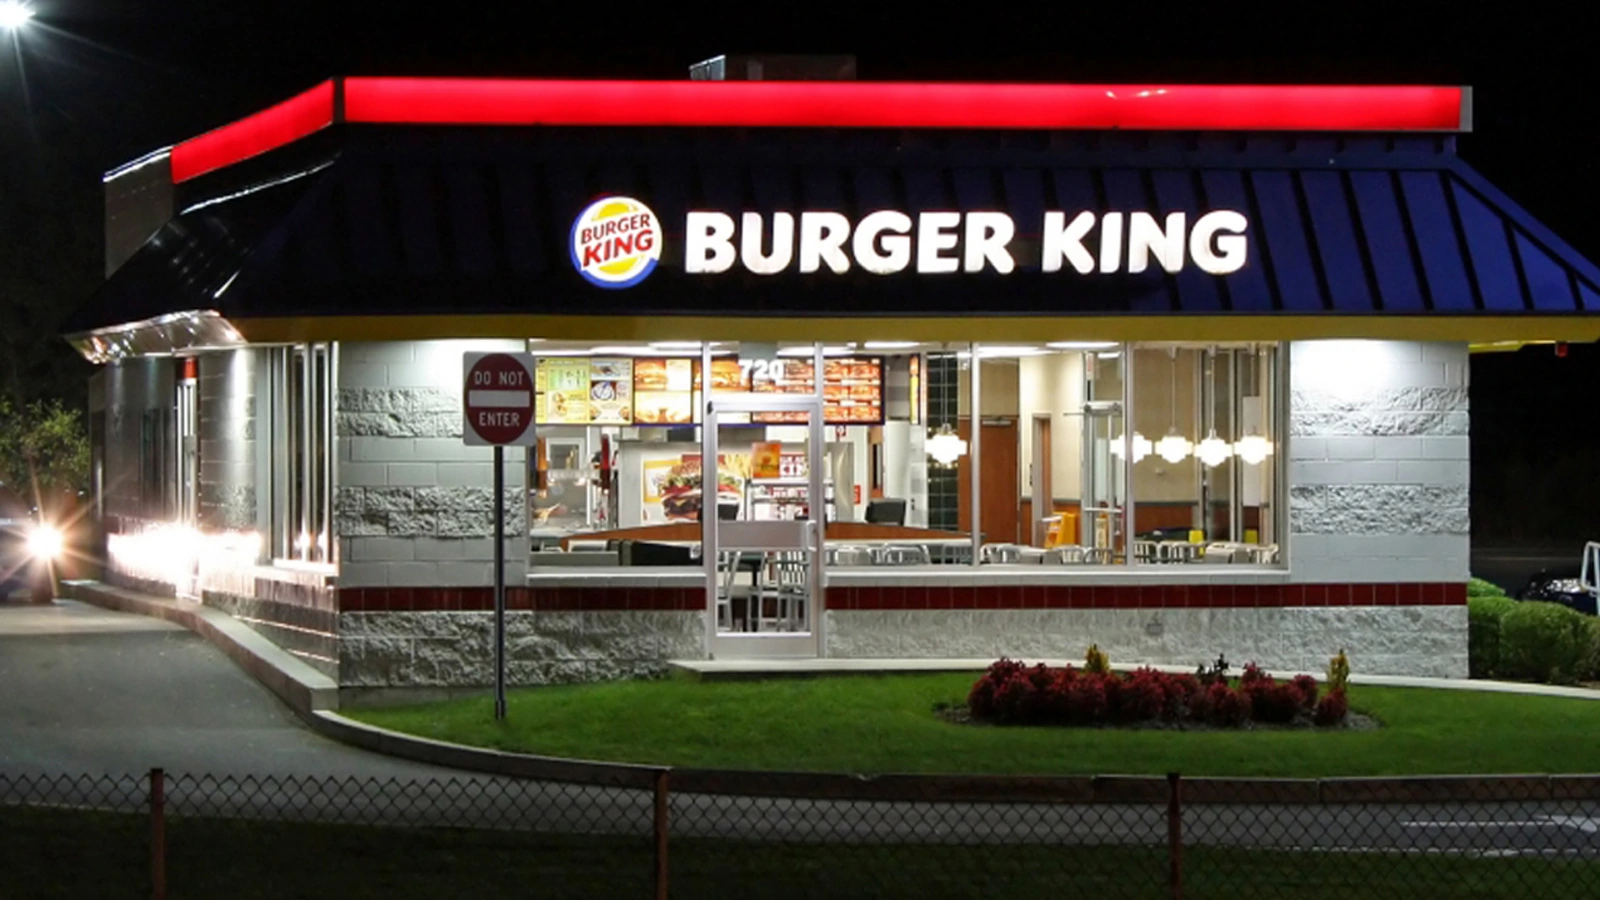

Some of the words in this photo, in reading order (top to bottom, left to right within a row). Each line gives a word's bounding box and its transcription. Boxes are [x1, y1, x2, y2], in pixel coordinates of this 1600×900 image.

[580, 213, 651, 245] BURGER
[685, 210, 1015, 275] BURGER
[1041, 209, 1249, 275] KING
[583, 229, 654, 268] KING
[474, 370, 492, 386] DO
[498, 370, 525, 386] NOT
[738, 358, 785, 381] 720
[478, 411, 521, 427] ENTER
